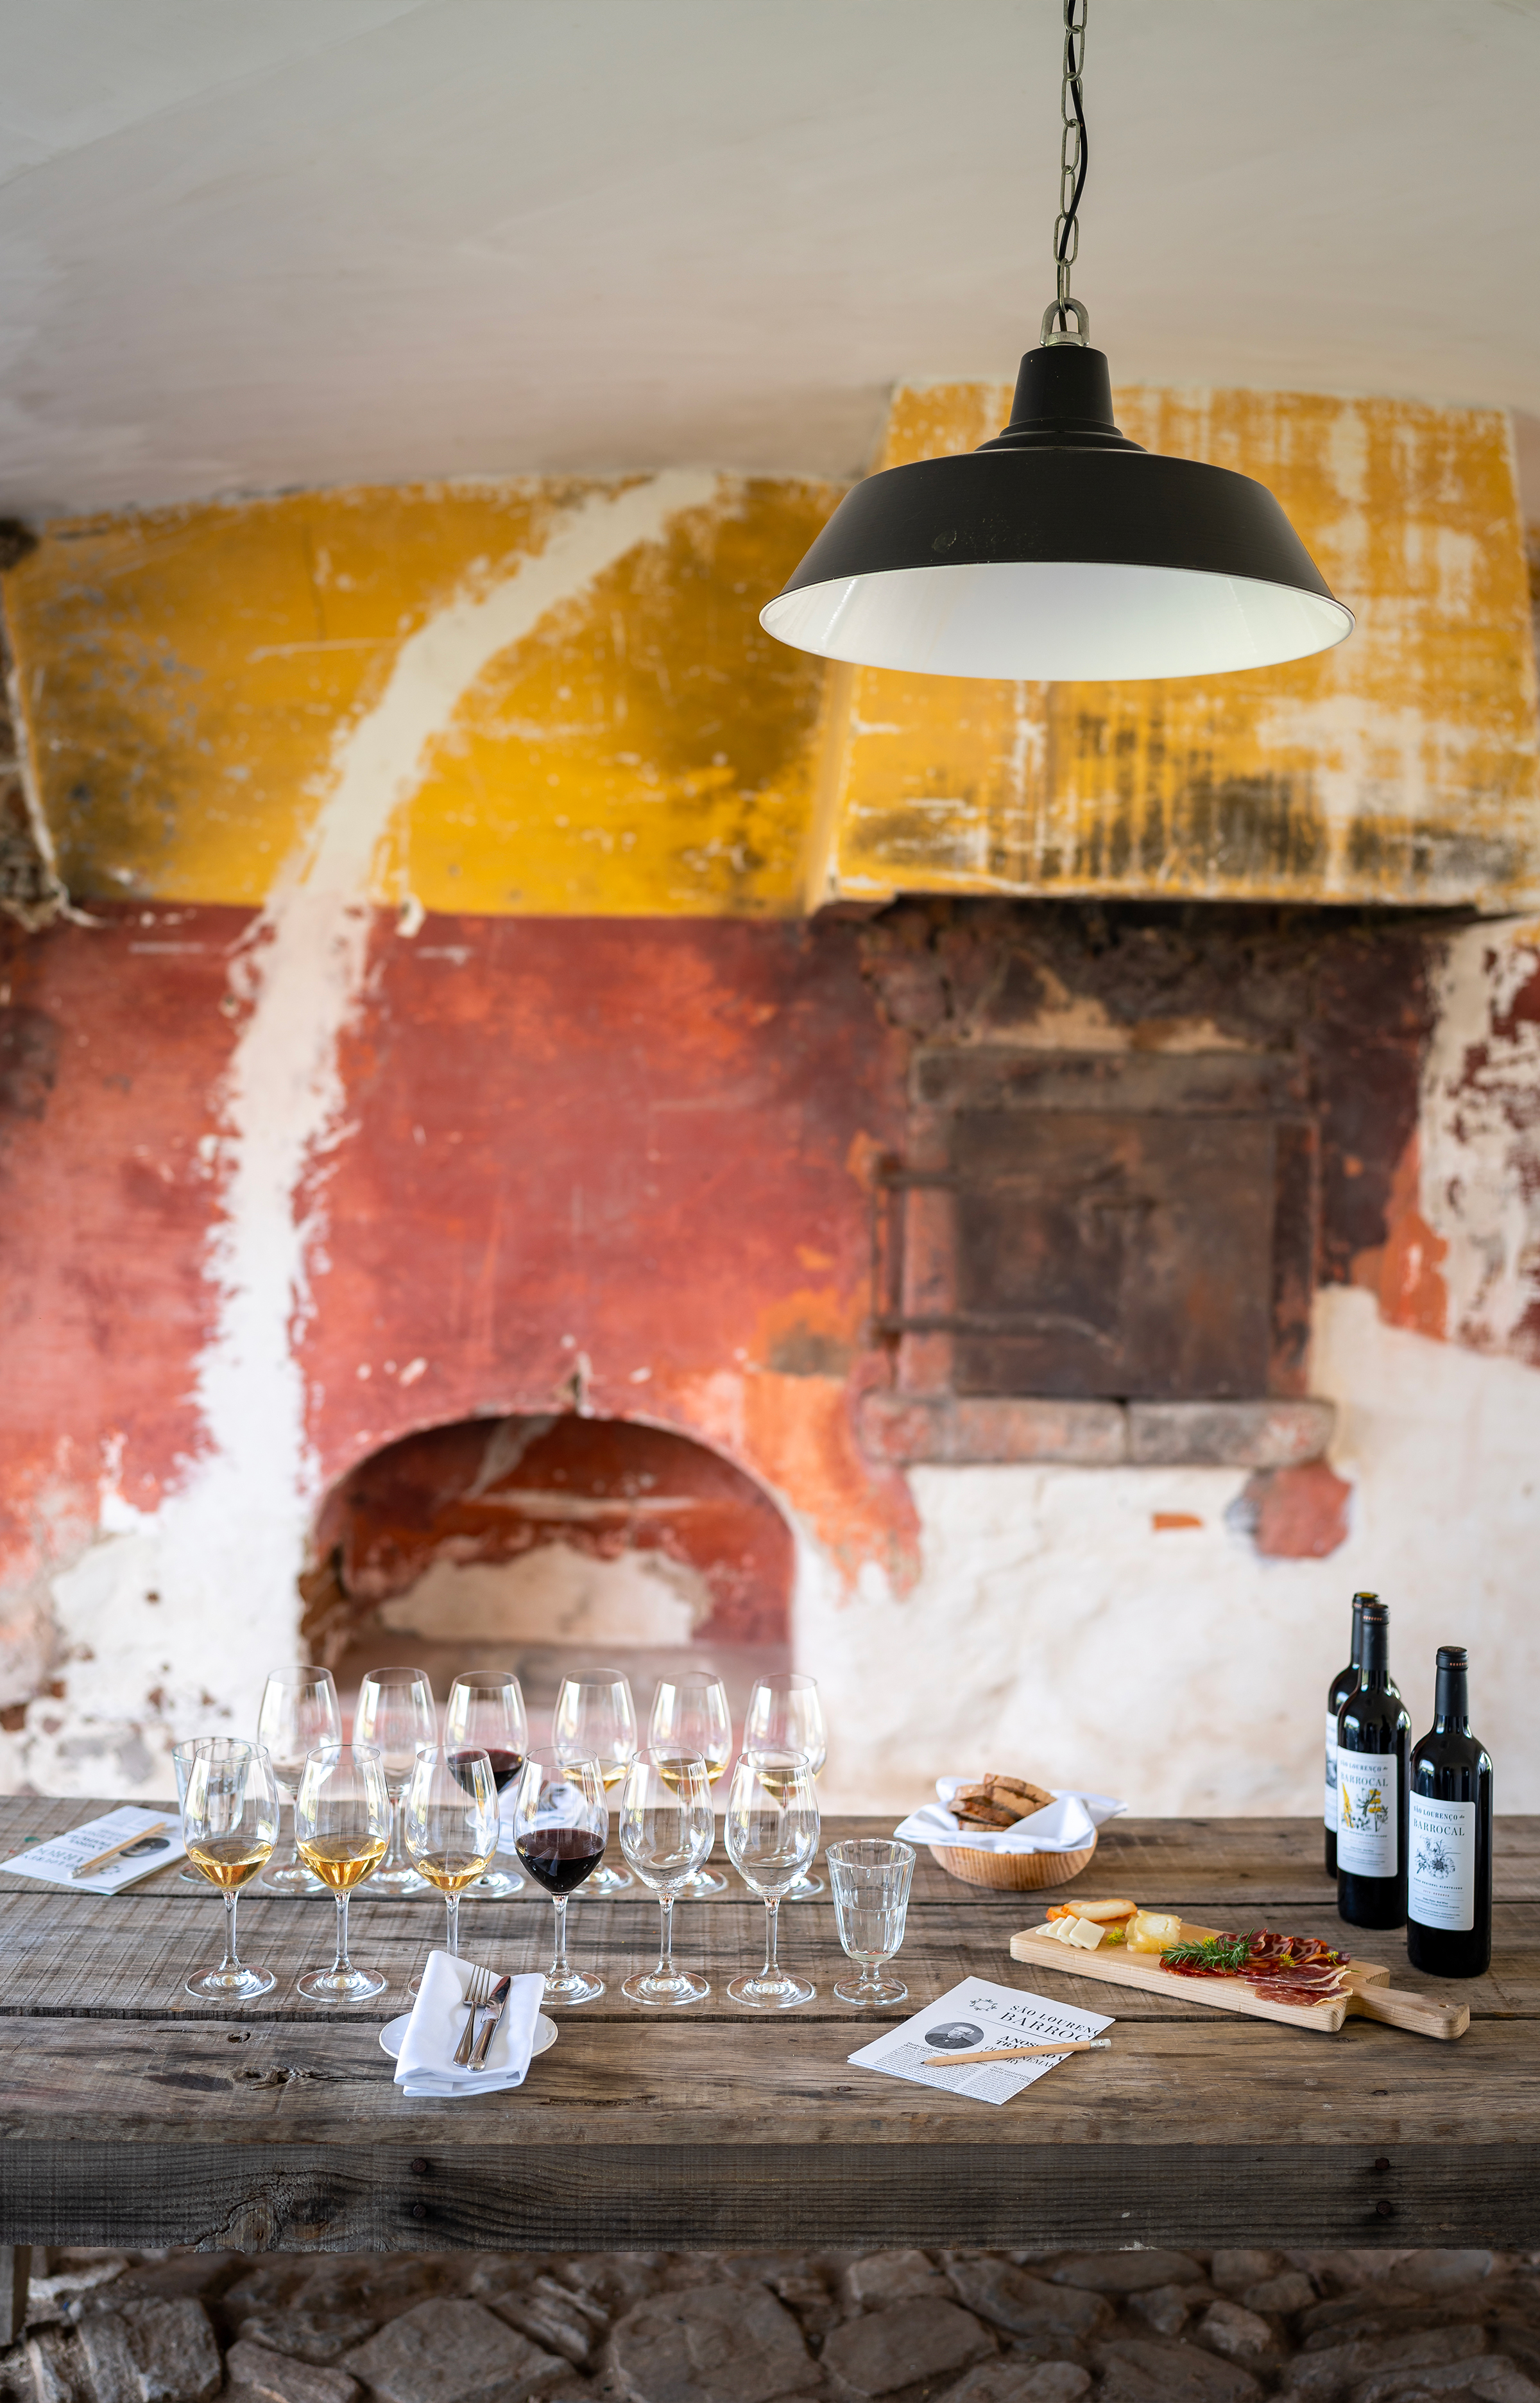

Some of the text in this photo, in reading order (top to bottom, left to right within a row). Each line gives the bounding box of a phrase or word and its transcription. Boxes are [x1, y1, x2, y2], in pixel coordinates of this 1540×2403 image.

[1340, 1771, 1389, 1787] BARROCAL
[1423, 1809, 1458, 1822] LOURENÇO
[1414, 1818, 1465, 1836] BARROCAL
[1009, 2004, 1036, 2016] SÃO
[992, 2065, 1032, 2080] Self-sustaining
